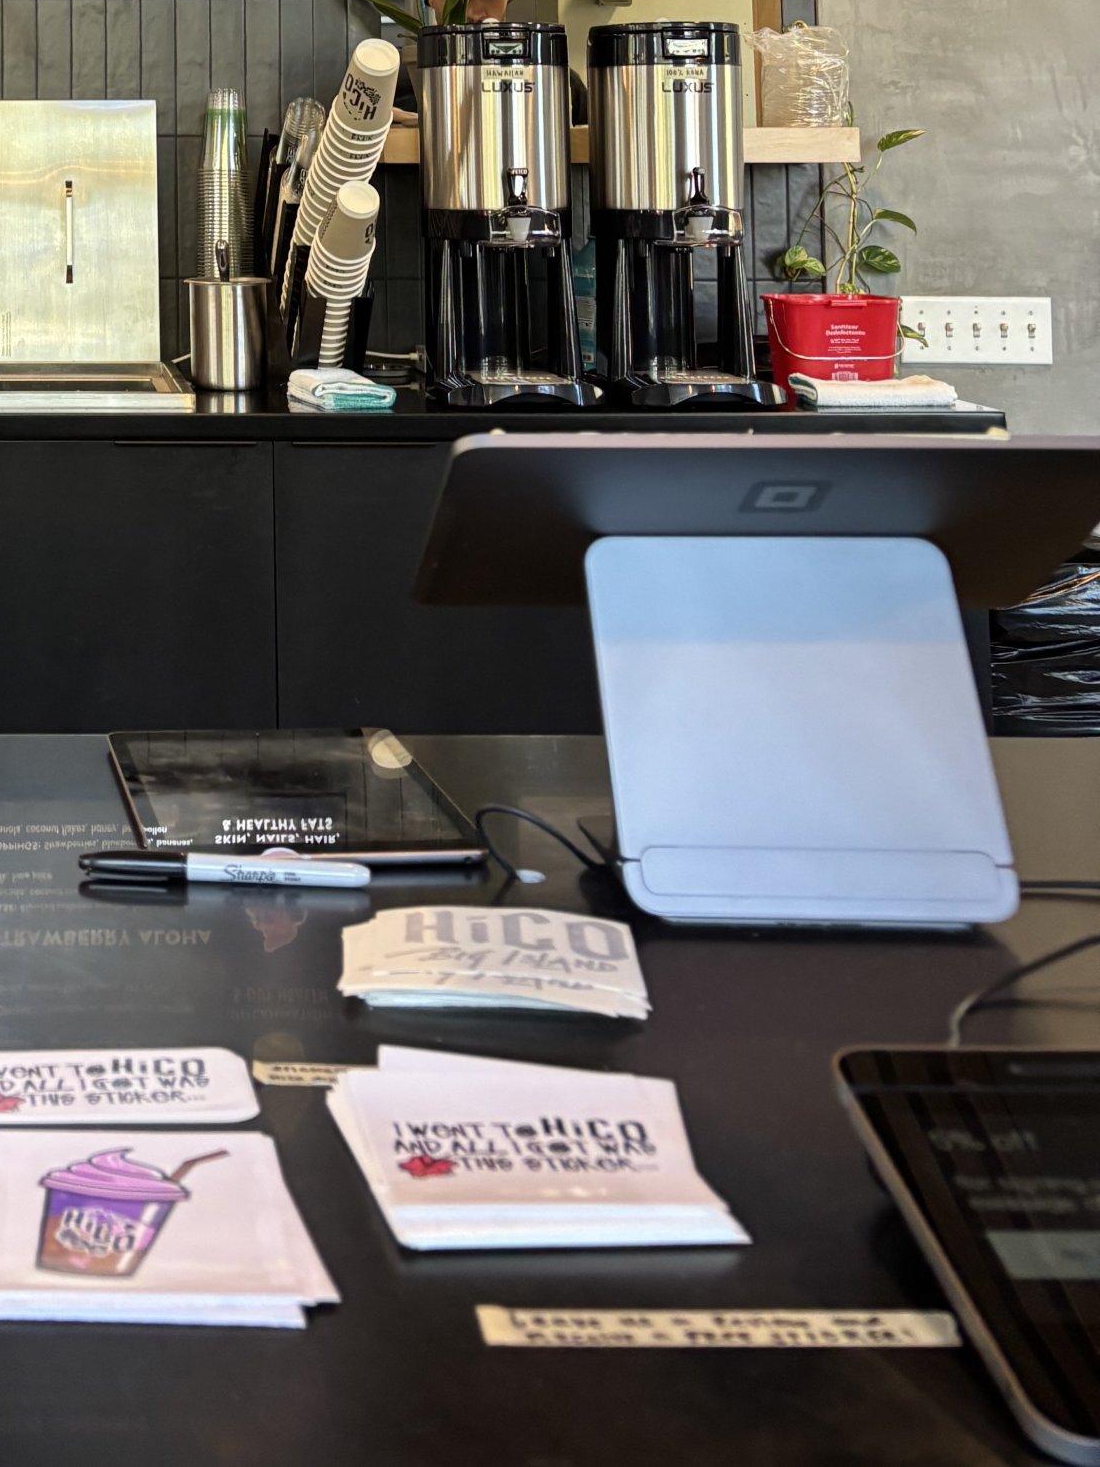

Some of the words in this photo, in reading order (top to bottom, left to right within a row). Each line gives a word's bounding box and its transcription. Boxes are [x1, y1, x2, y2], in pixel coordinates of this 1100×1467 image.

[481, 82, 533, 93] LUXUS
[662, 82, 713, 93] LUXUS
[224, 865, 276, 882] Sharpie
